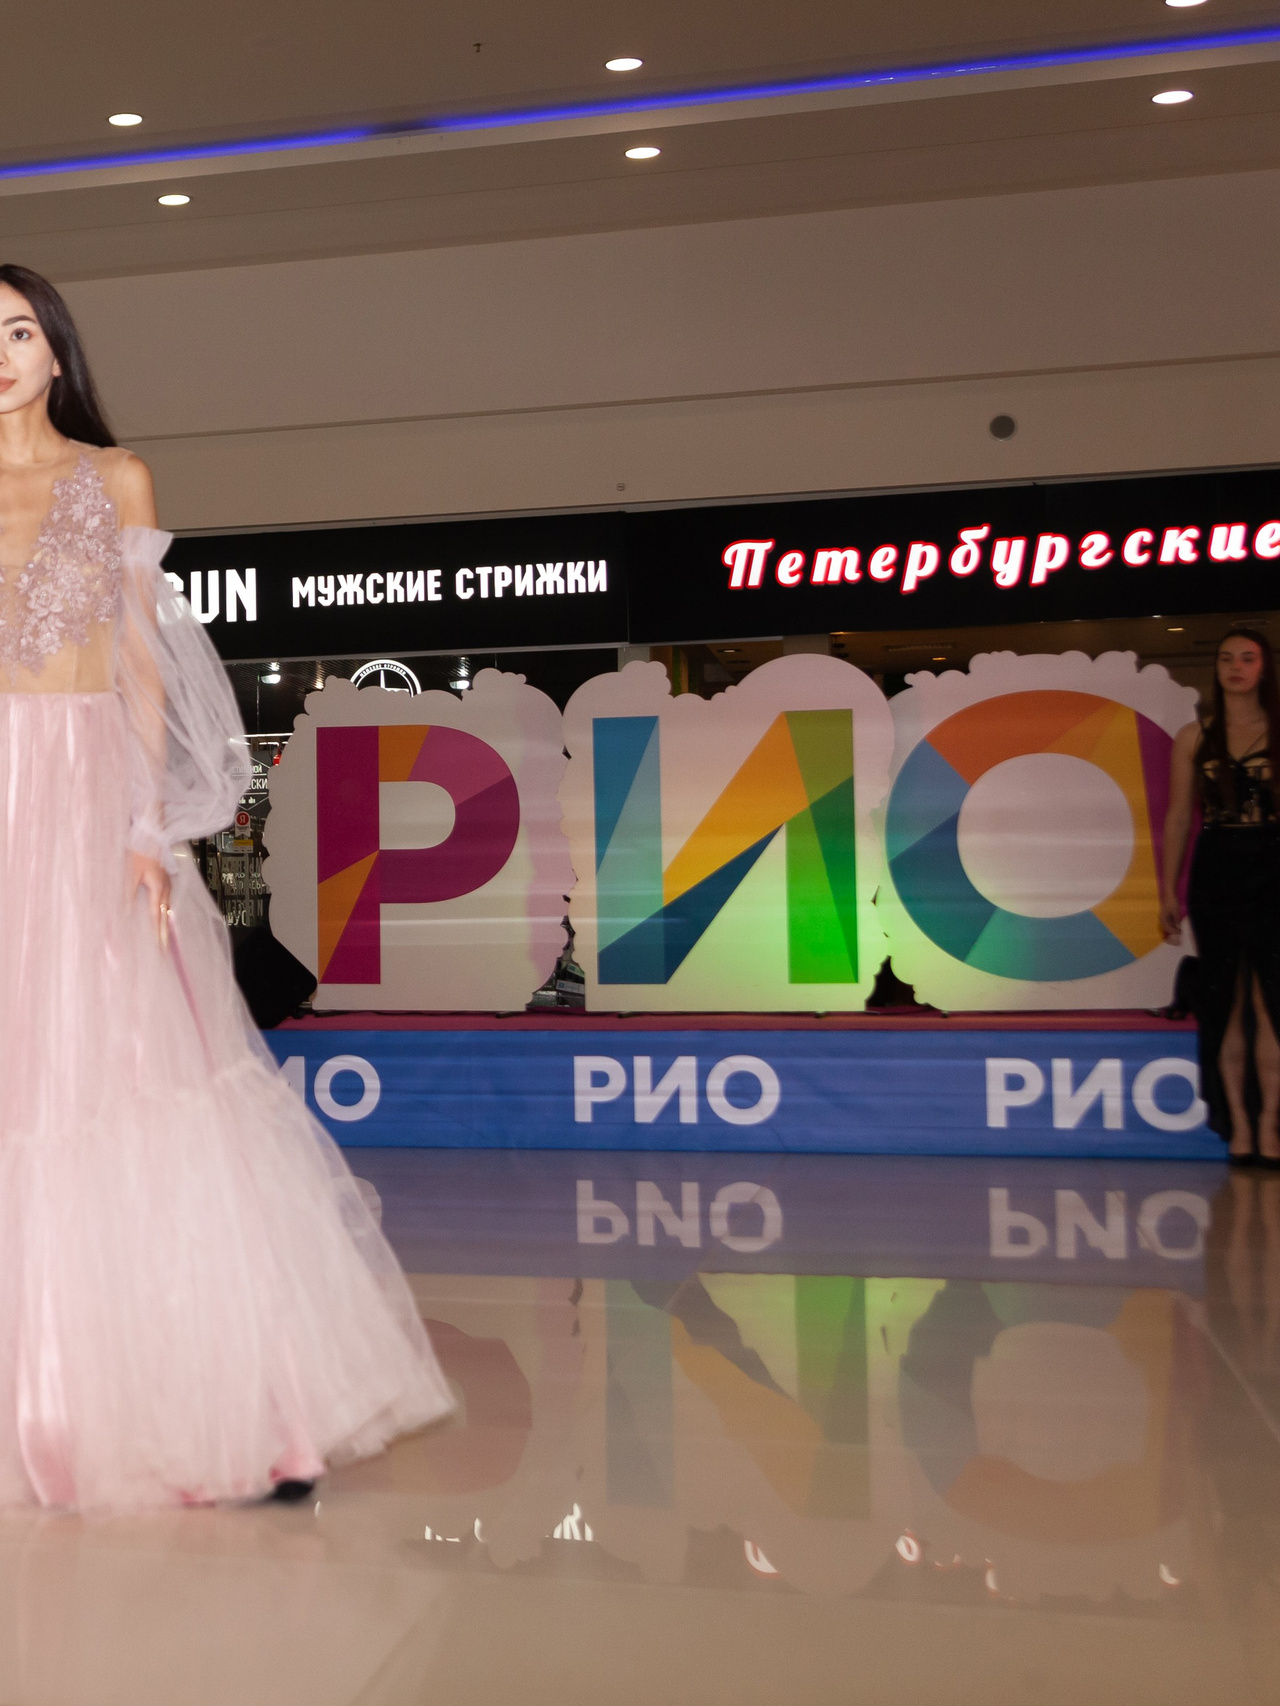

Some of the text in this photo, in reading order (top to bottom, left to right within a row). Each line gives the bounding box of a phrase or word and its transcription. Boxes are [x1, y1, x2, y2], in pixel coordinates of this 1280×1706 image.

[291, 559, 608, 608] МУЖСКИЕ СТРИЖКИ
[723, 520, 1280, 594] Петербургские
[316, 689, 1204, 984] РИО
[574, 1055, 782, 1125] РИО
[986, 1056, 1207, 1133] РИО
